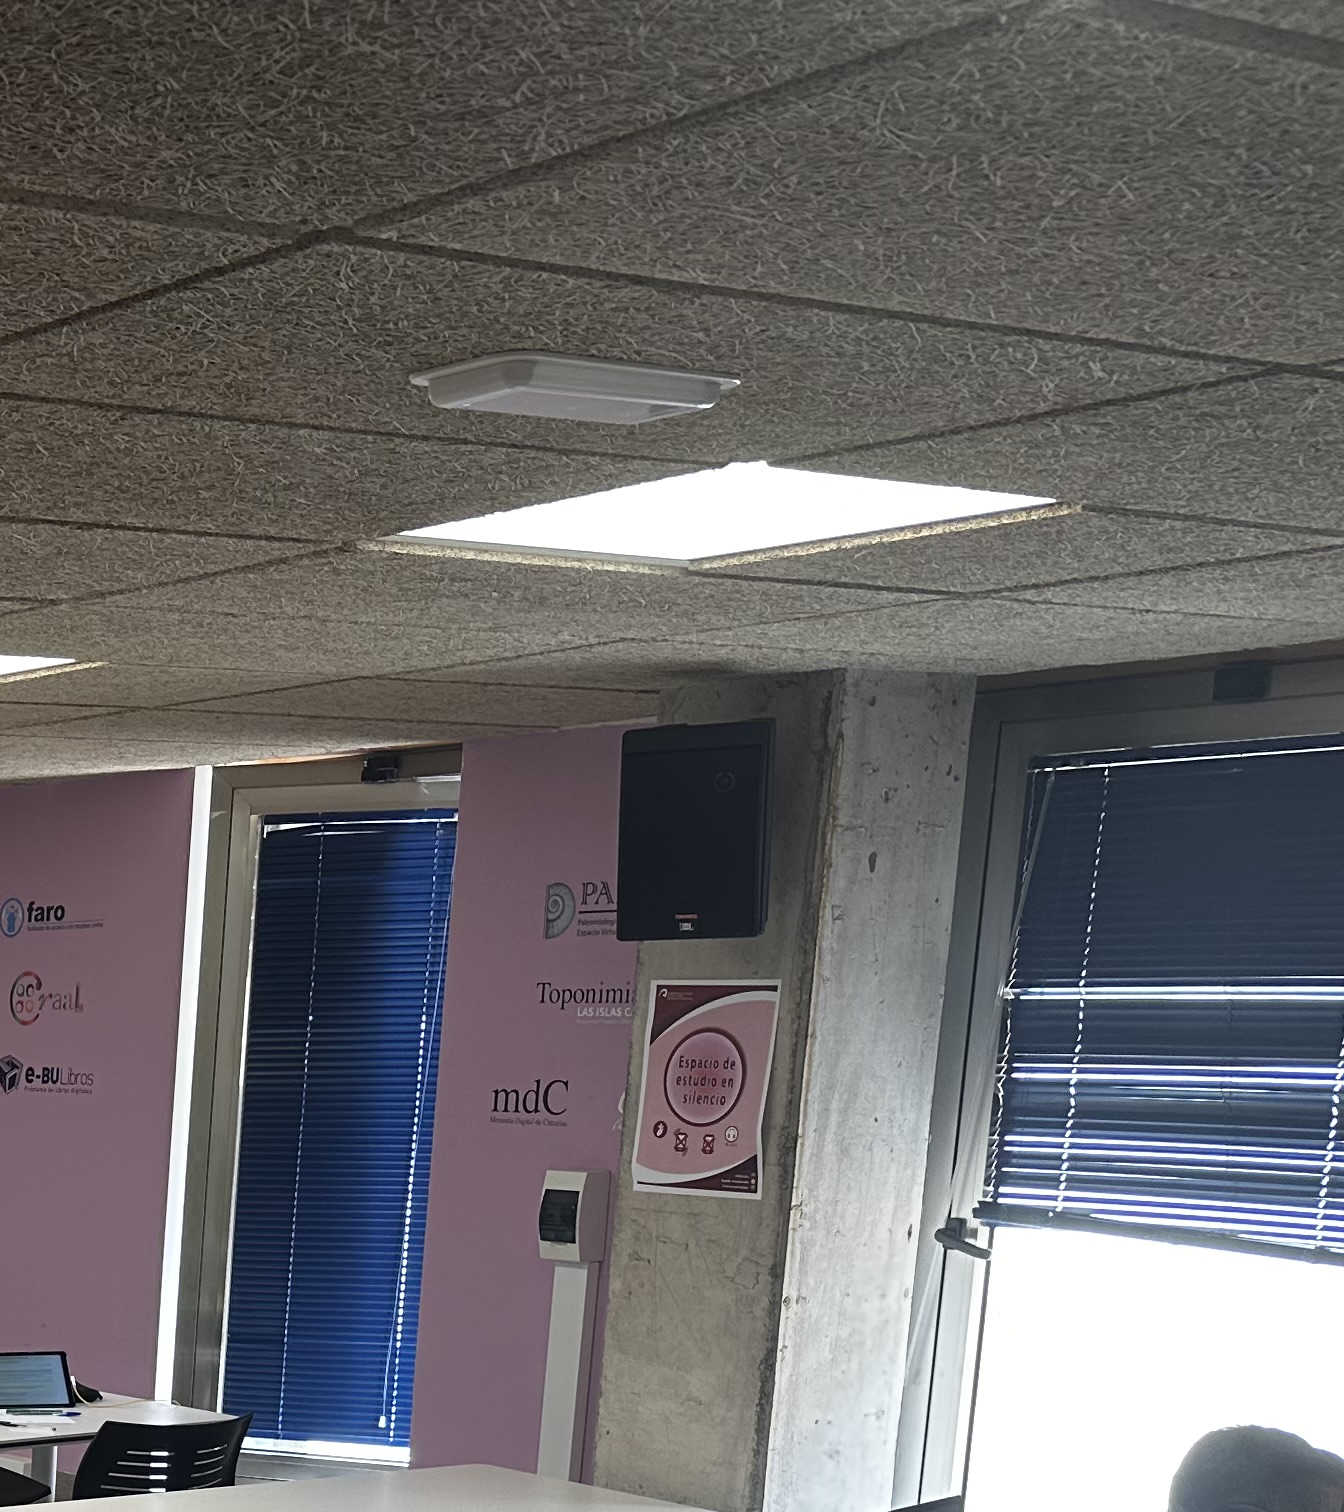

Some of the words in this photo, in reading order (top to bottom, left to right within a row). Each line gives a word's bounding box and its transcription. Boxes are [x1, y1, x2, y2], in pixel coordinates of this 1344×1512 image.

[580, 881, 615, 906] PA
[26, 900, 66, 923] faro
[536, 980, 634, 1010] Toponimi
[577, 1006, 594, 1017] LAS
[596, 1006, 621, 1017] ISLAS
[678, 1055, 718, 1071] Espacio
[722, 1056, 736, 1070] de
[675, 1074, 717, 1088] estudio
[721, 1076, 734, 1089] en
[491, 1078, 569, 1116] mdC
[682, 1090, 726, 1106] silencio
